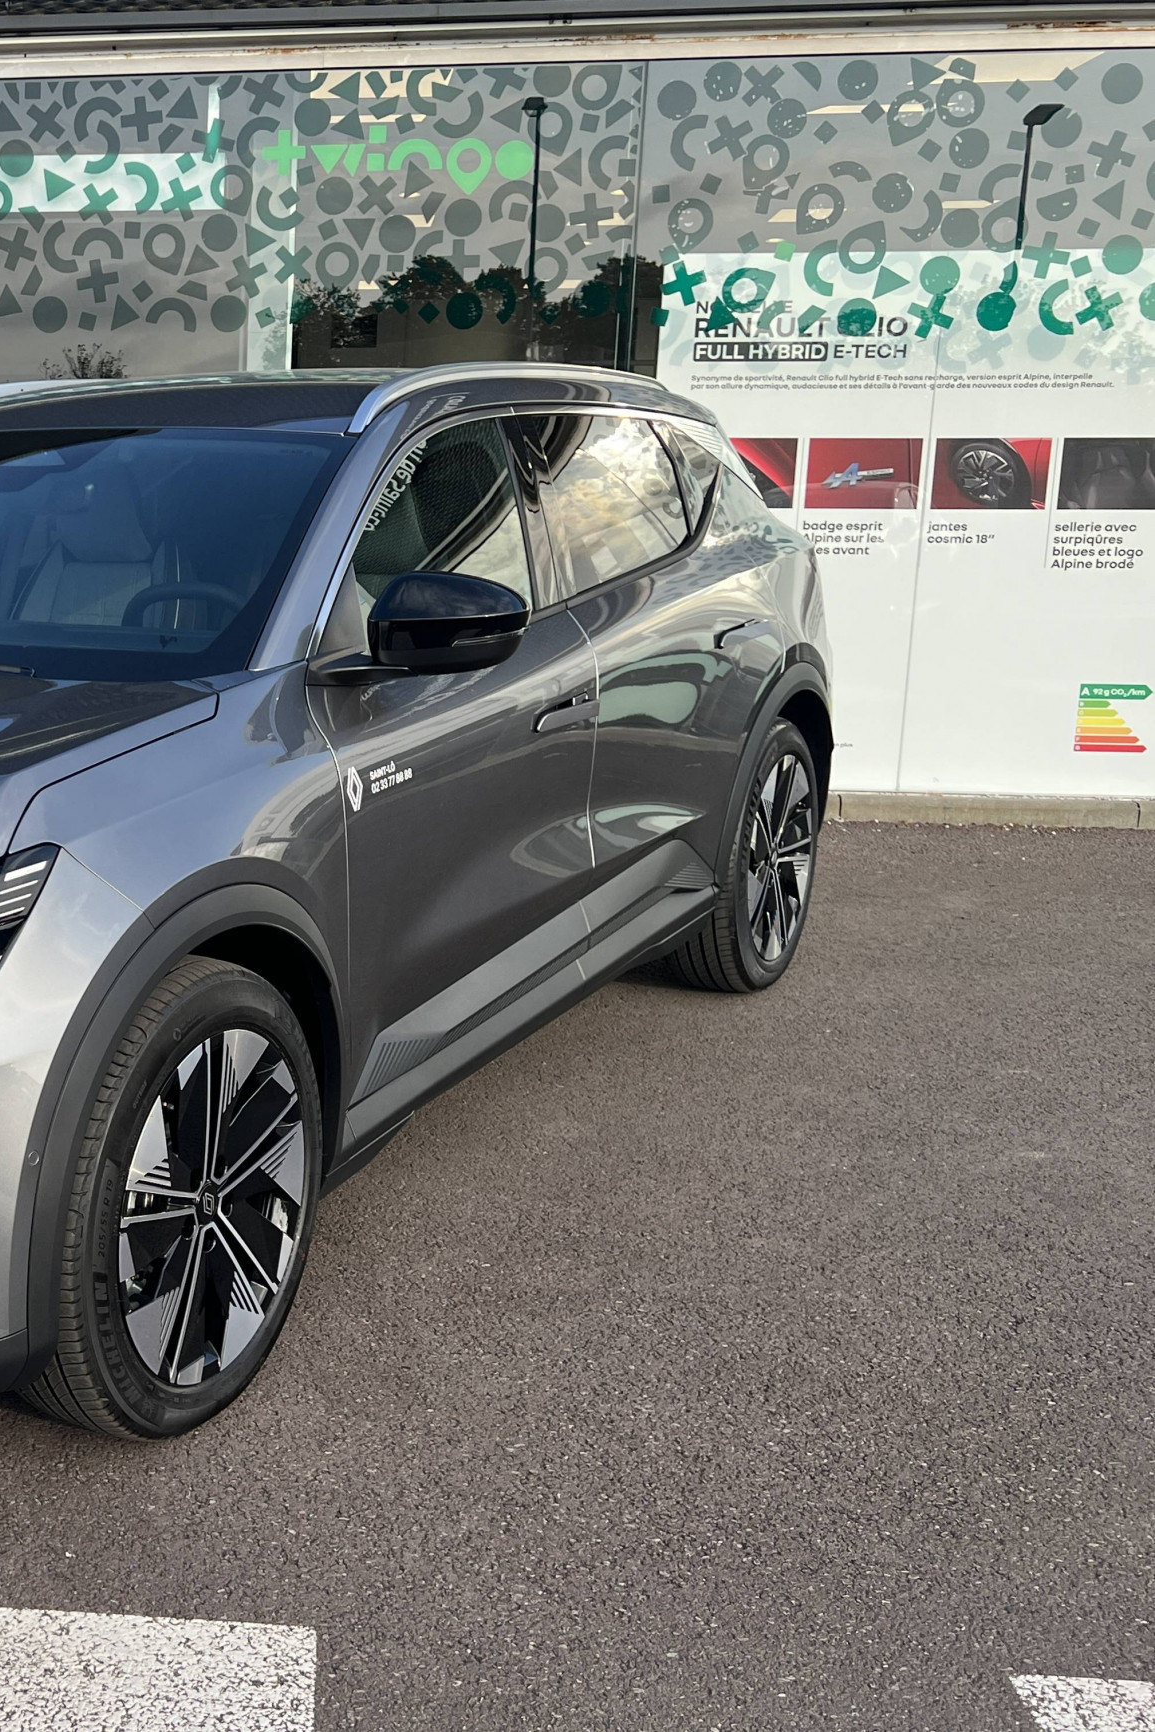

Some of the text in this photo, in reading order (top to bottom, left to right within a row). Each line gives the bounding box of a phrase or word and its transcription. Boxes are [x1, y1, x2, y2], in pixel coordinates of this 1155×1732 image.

[695, 344, 907, 360] FULL HYBRID E-TECH
[691, 374, 732, 383] Synonyme
[733, 374, 743, 382] de
[744, 374, 785, 383] sportivité,
[786, 374, 817, 382] Renault
[818, 374, 834, 382] Clio
[835, 374, 848, 382] full
[849, 374, 875, 383] hybrid
[876, 374, 903, 382] E-Tech
[925, 374, 965, 383] recharge,
[998, 373, 1022, 382] esprit
[1023, 373, 1052, 382] Alpine,
[1053, 372, 1094, 381] interpelle
[690, 383, 704, 391] par
[721, 382, 743, 390] allure
[744, 382, 790, 391] dynamique,
[791, 382, 838, 390] audacieuse
[839, 382, 848, 390] et
[863, 382, 891, 390] détails
[1013, 381, 1038, 389] codes
[1039, 381, 1050, 389] du
[1051, 381, 1079, 390] design
[802, 520, 884, 533] badge esprit
[926, 521, 968, 534] jantes
[1054, 521, 1138, 532] sellerie avec
[803, 533, 885, 544] Alpine sur les
[927, 534, 973, 544] cosmic
[1053, 534, 1124, 547] surpiqûres
[832, 546, 870, 555] avant
[1052, 546, 1144, 560] bleues et logo
[1051, 557, 1135, 571] Alpine brodé
[1081, 686, 1090, 696] A
[1104, 689, 1110, 697] g
[369, 760, 396, 781] SAINT-LÔ
[371, 782, 381, 794] 02
[380, 778, 389, 791] 33
[388, 774, 396, 787] 77
[97, 1179, 115, 1259] 205/55 R 19
[93, 1278, 142, 1406] MICHELIN
